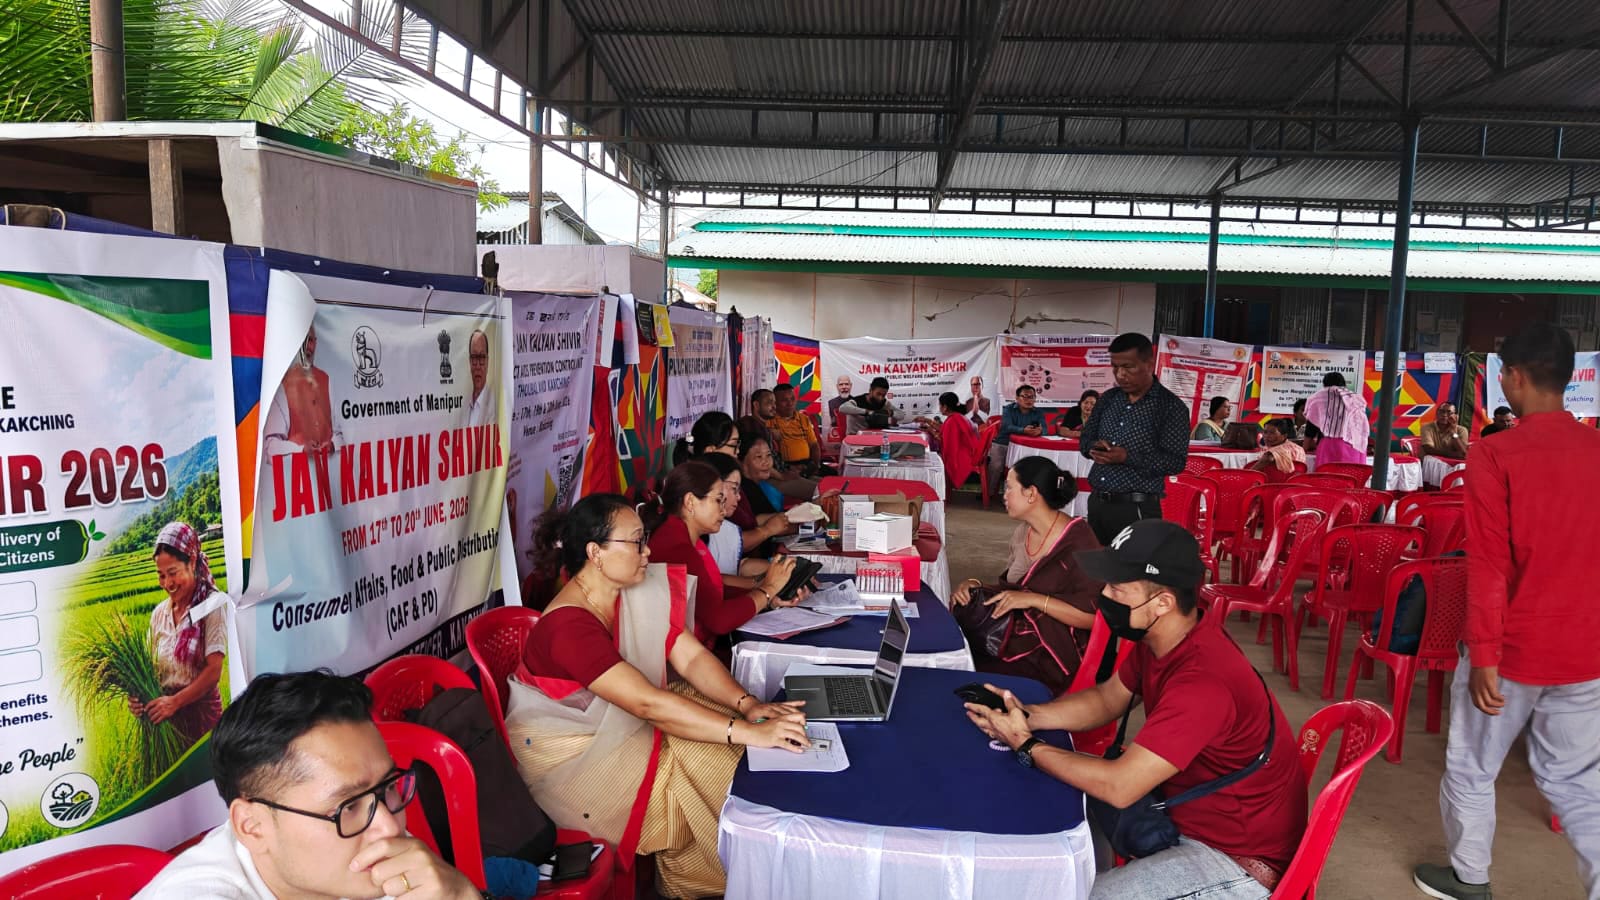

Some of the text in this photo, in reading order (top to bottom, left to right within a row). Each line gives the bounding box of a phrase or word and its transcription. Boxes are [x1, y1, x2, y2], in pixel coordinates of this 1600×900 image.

[529, 332, 557, 353] KALYAN
[557, 331, 582, 351] SHIVIR
[859, 361, 967, 375] JAN KALYAN SHIVIR
[341, 393, 464, 419] Government of Manipur
[60, 442, 168, 509] 2026
[271, 447, 333, 522] JAN
[340, 433, 431, 505] KALYAN
[438, 423, 504, 482] SHIVIR
[46, 526, 61, 541] of
[341, 495, 469, 557] FROM 17th TO 20th JUNE, 2026
[0, 550, 56, 567] Citizens
[355, 572, 390, 608] Affairs,
[391, 557, 415, 590] Food
[417, 554, 425, 579] &
[427, 543, 456, 574] Public
[386, 588, 438, 641] (CAF & PD)
[0, 711, 53, 728] hemes.
